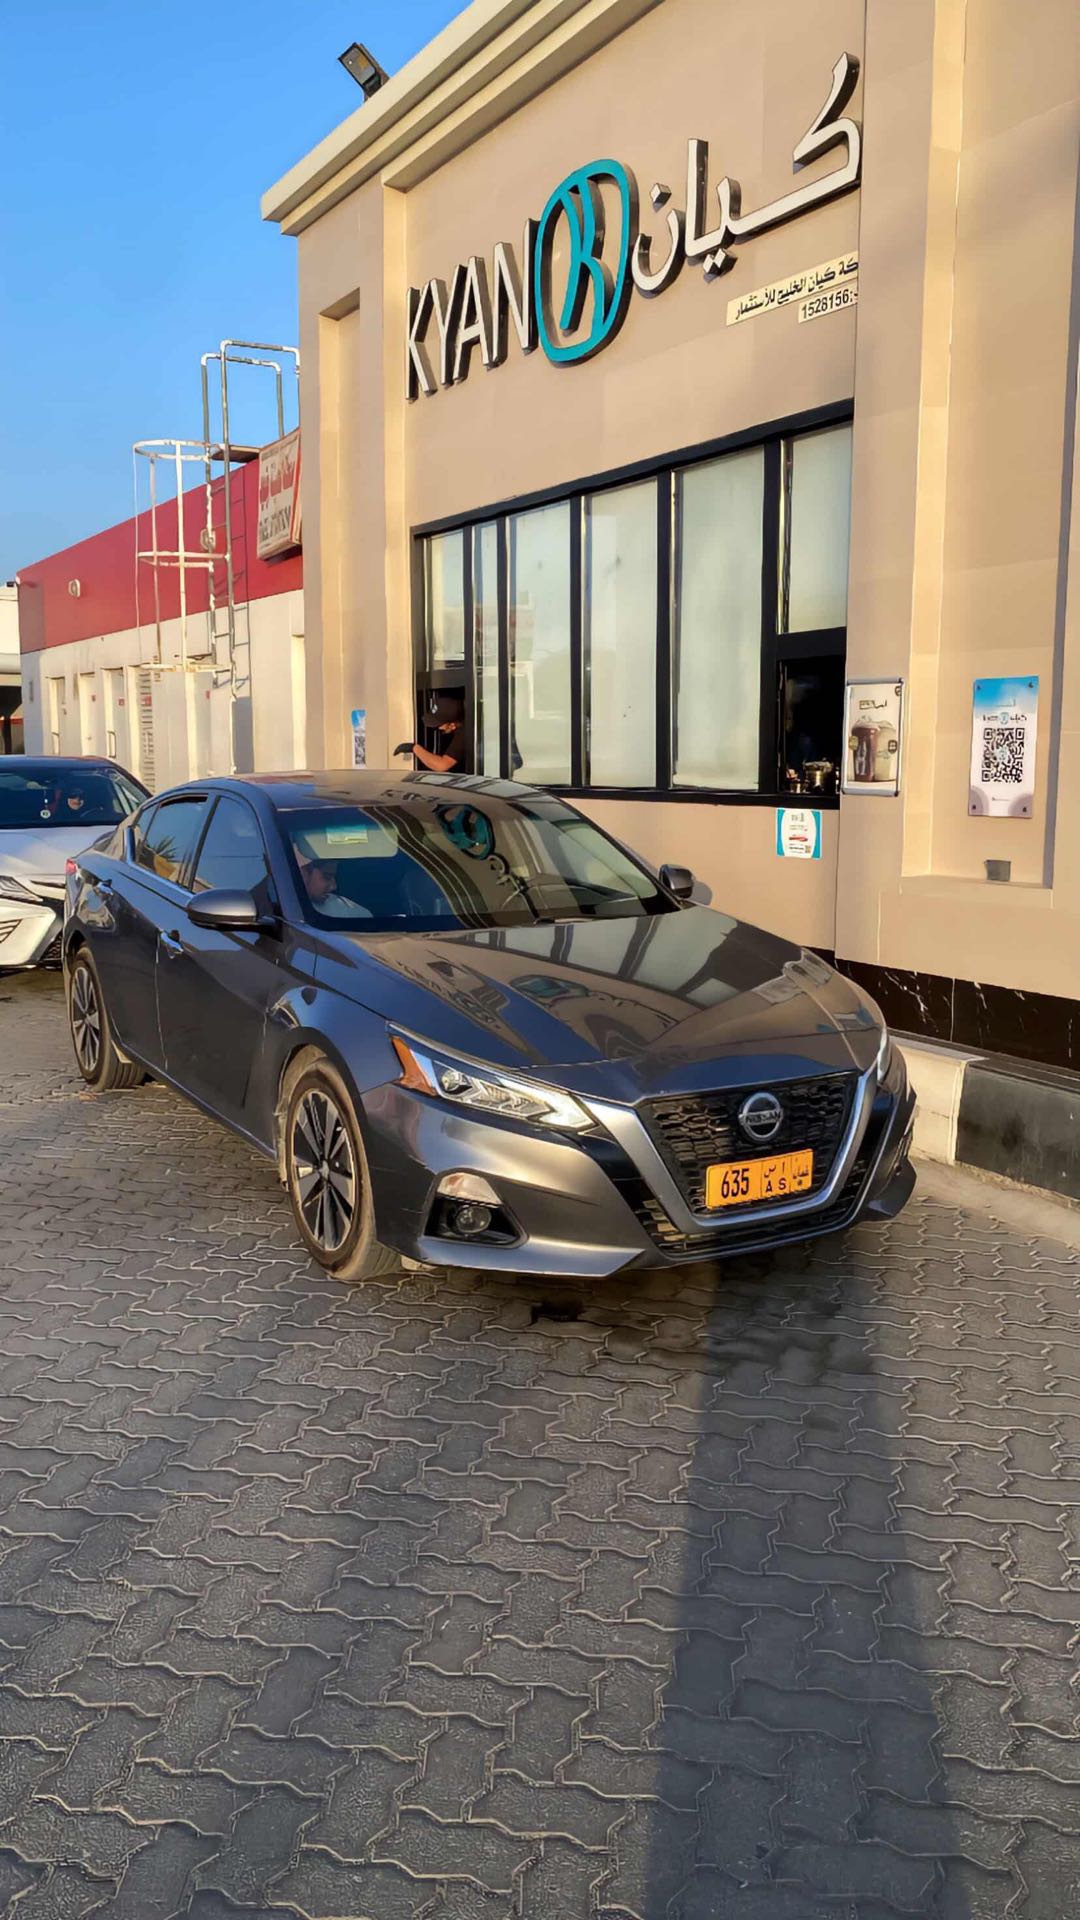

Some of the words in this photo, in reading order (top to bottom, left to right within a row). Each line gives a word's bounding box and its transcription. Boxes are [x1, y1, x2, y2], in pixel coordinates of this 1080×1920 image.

[632, 51, 863, 297] كيان
[405, 217, 539, 402] KYAN
[745, 1110, 780, 1122] NISSAN
[721, 1168, 750, 1199] 635
[765, 1180, 773, 1193] A
[778, 1177, 787, 1190] S
